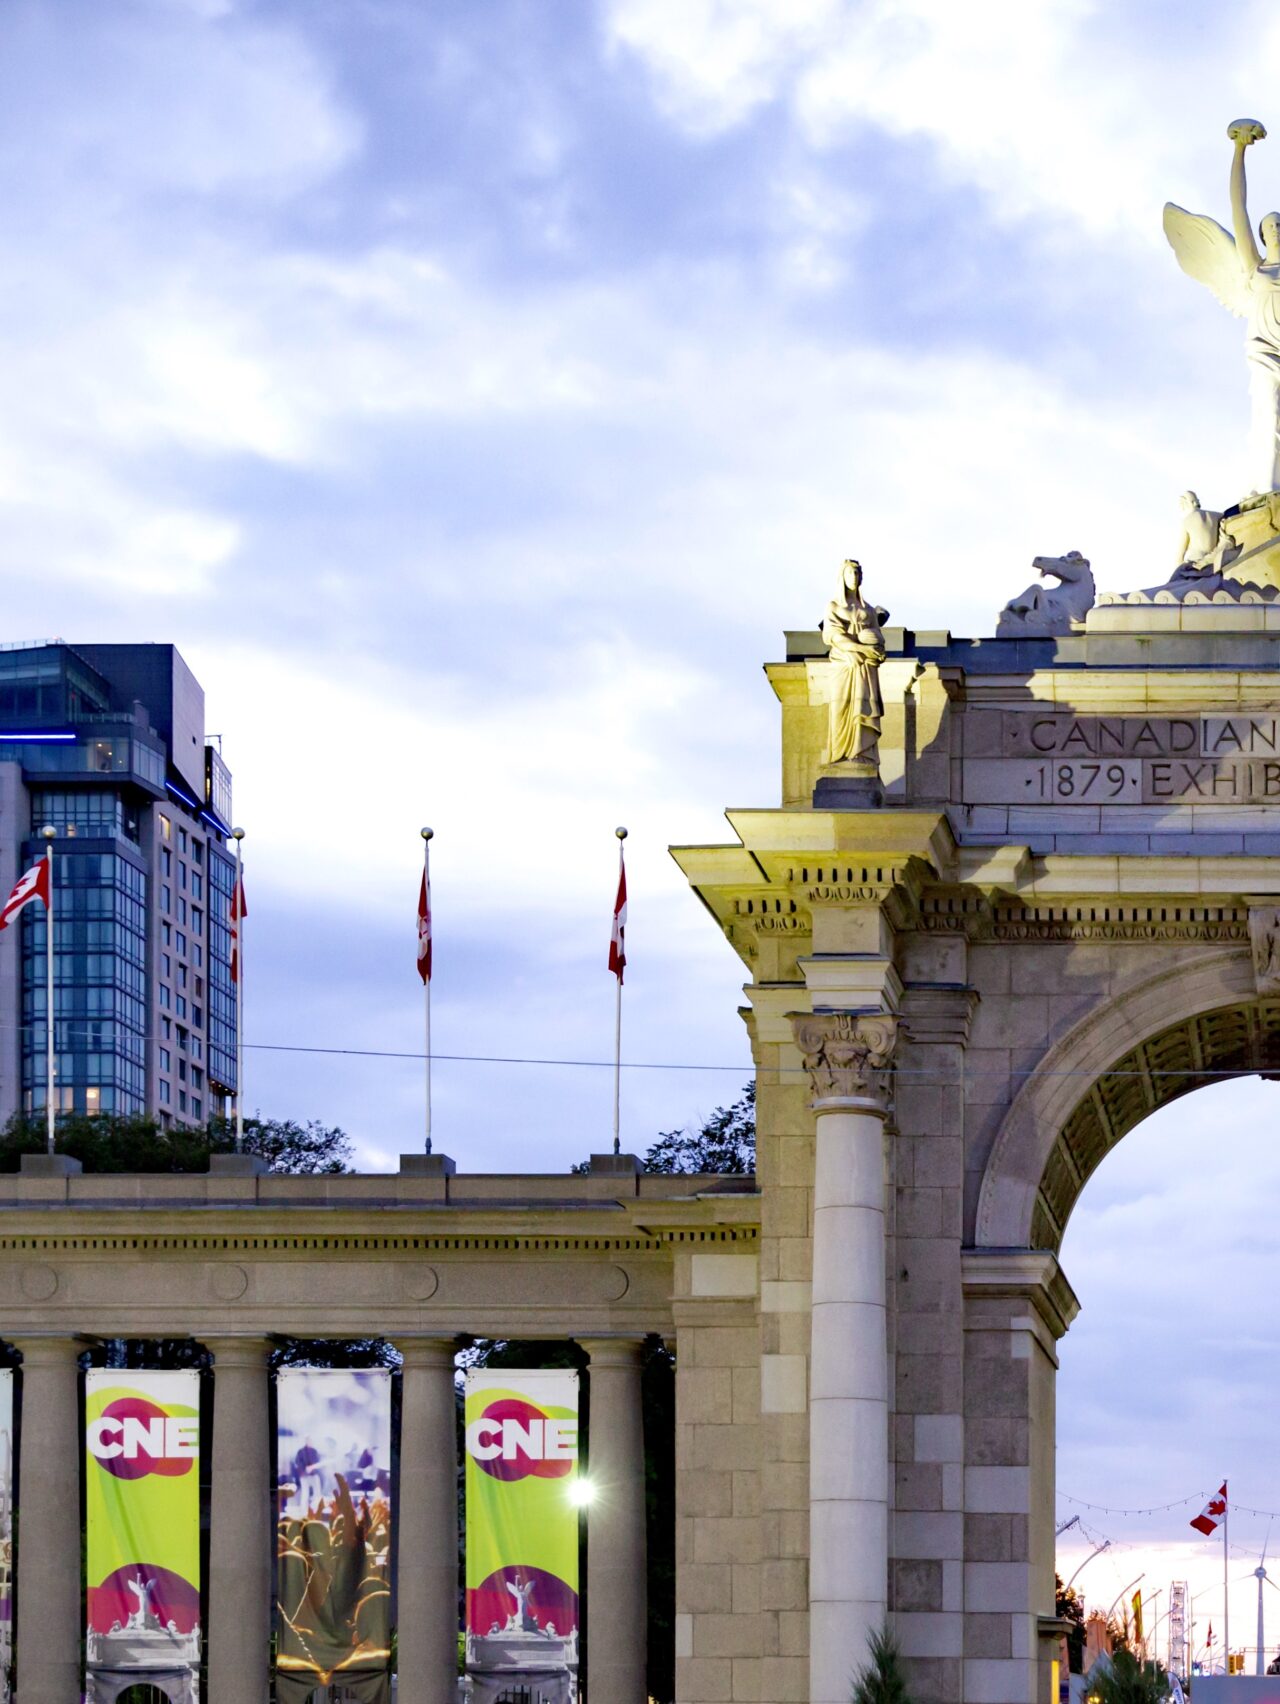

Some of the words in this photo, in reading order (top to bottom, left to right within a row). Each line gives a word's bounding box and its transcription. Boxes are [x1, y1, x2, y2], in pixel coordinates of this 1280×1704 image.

[1030, 719, 1276, 753] CANADIAN
[1037, 764, 1125, 797] 1879
[86, 1416, 199, 1459] CNE
[466, 1418, 578, 1460] CNE
